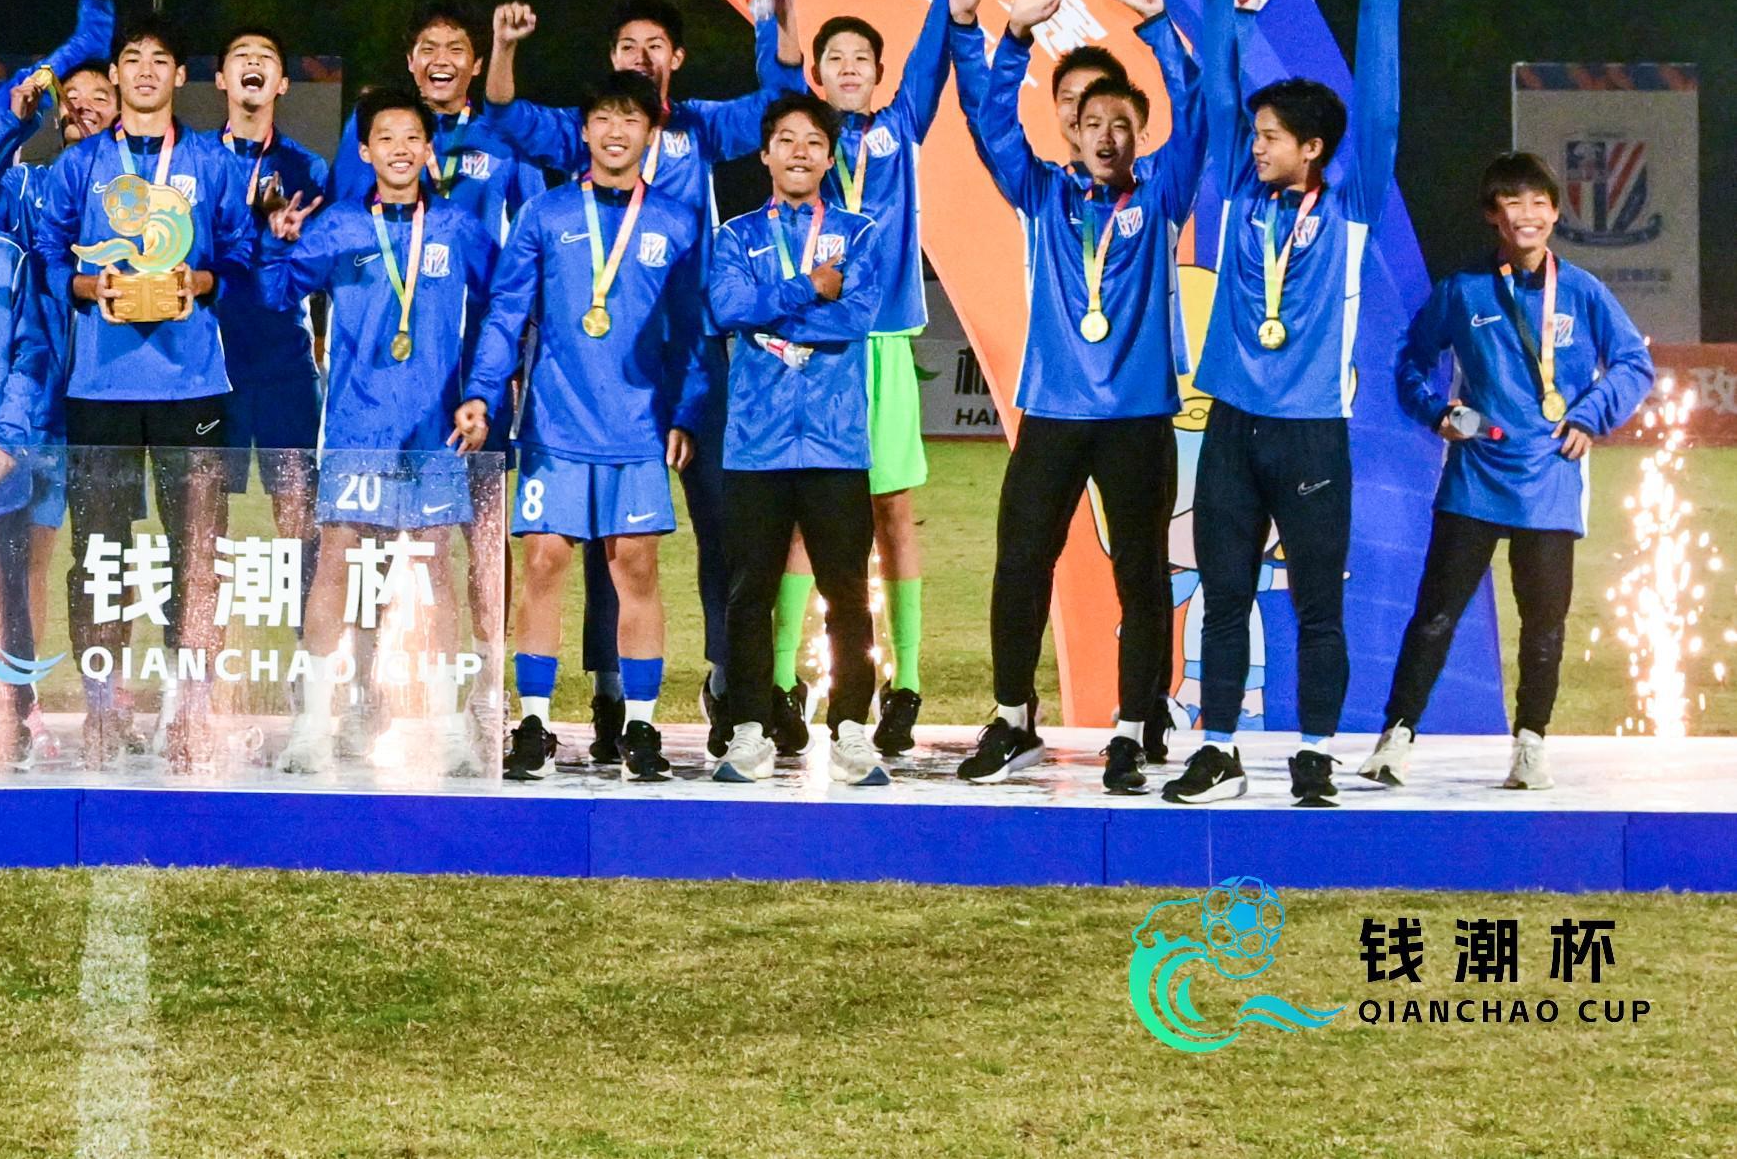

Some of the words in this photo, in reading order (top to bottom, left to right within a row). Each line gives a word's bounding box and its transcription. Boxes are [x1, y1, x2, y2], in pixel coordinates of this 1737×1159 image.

[336, 473, 382, 513] 20
[522, 478, 545, 521] 8
[82, 533, 436, 630] 钱潮杯
[80, 646, 357, 683] QIANCHAO
[376, 652, 484, 686] CUP
